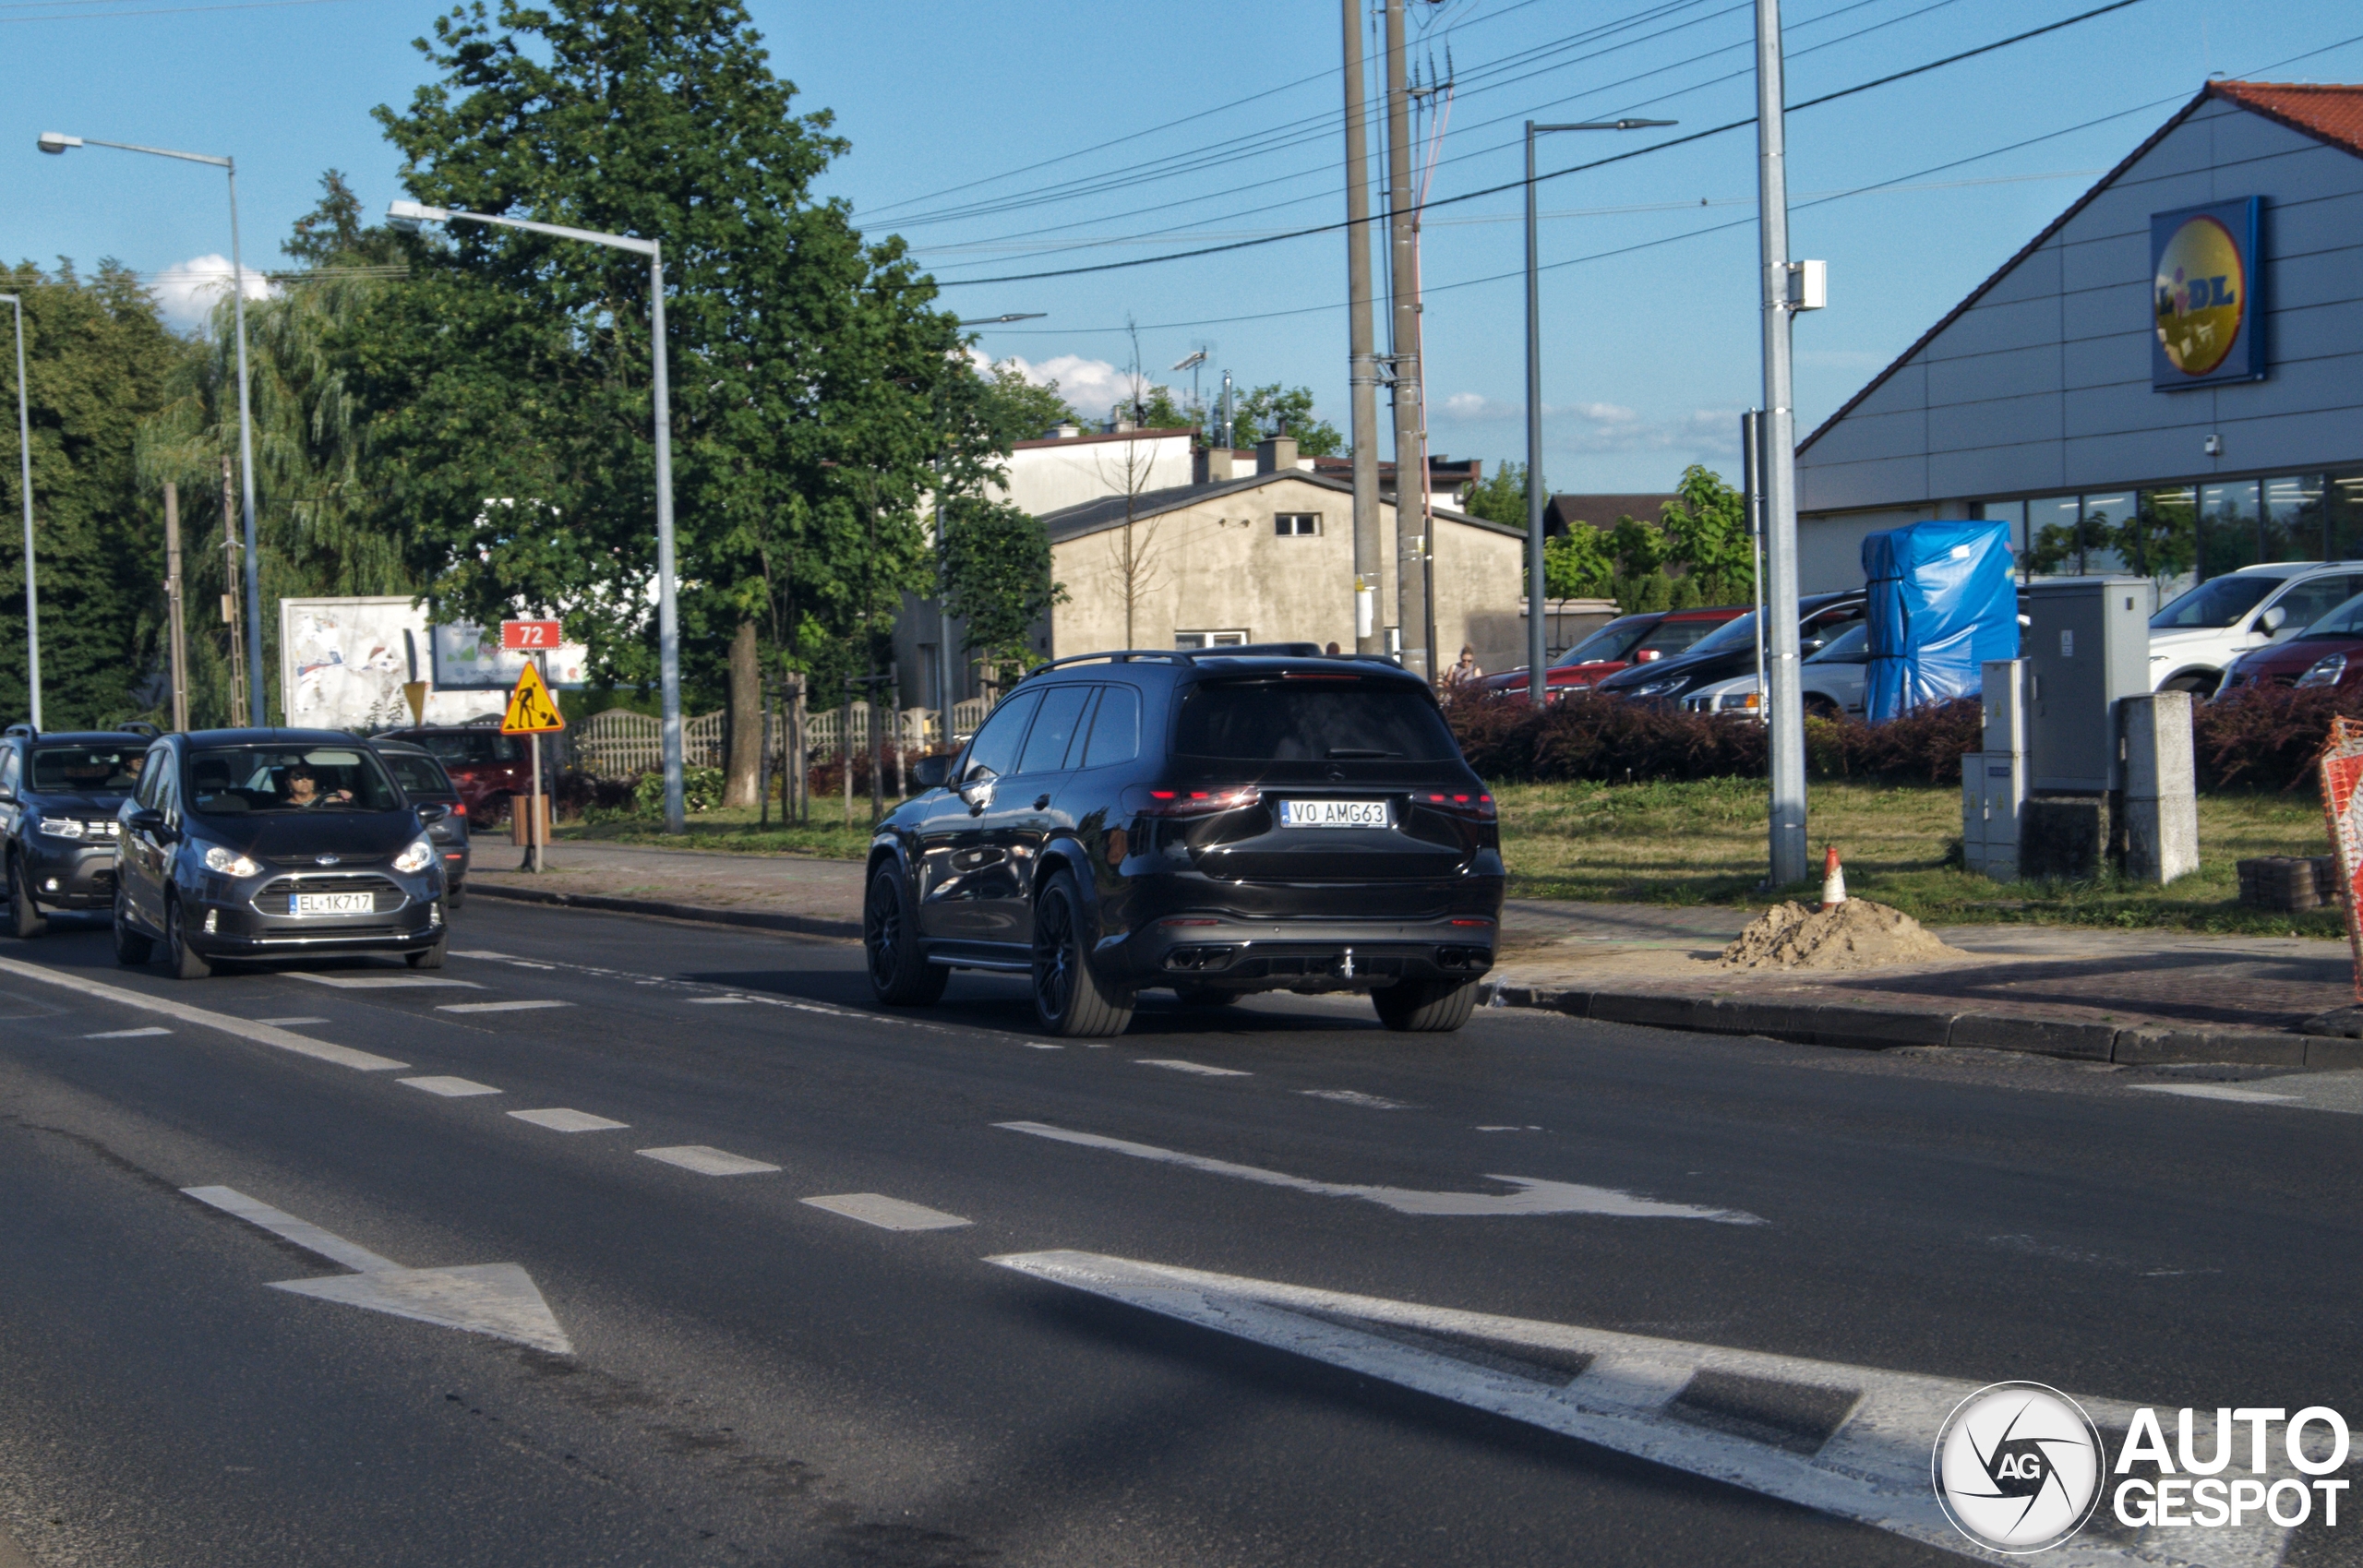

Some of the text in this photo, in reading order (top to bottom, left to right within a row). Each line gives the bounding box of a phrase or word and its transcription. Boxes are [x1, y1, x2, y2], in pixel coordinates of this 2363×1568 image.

[519, 626, 544, 644] 72
[1293, 803, 1384, 822] VO AMG63
[300, 894, 370, 911] EL 1K717
